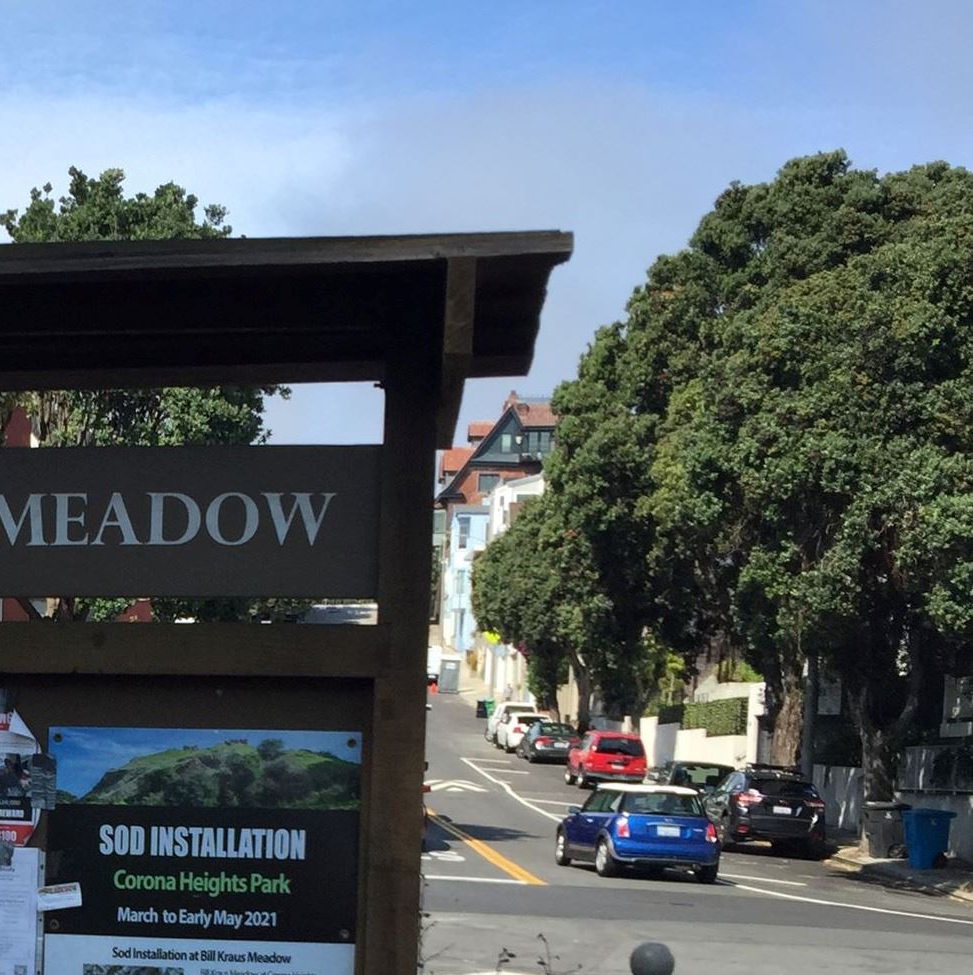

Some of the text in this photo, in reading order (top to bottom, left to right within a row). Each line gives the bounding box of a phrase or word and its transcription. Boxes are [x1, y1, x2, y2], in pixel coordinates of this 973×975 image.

[99, 824, 306, 860] SOD INSTALLATION
[113, 869, 291, 897] Corona Heights Park
[117, 907, 277, 929] March to Early May 2021
[112, 947, 291, 964] Sod Installation at Bill Kraus Meadow
